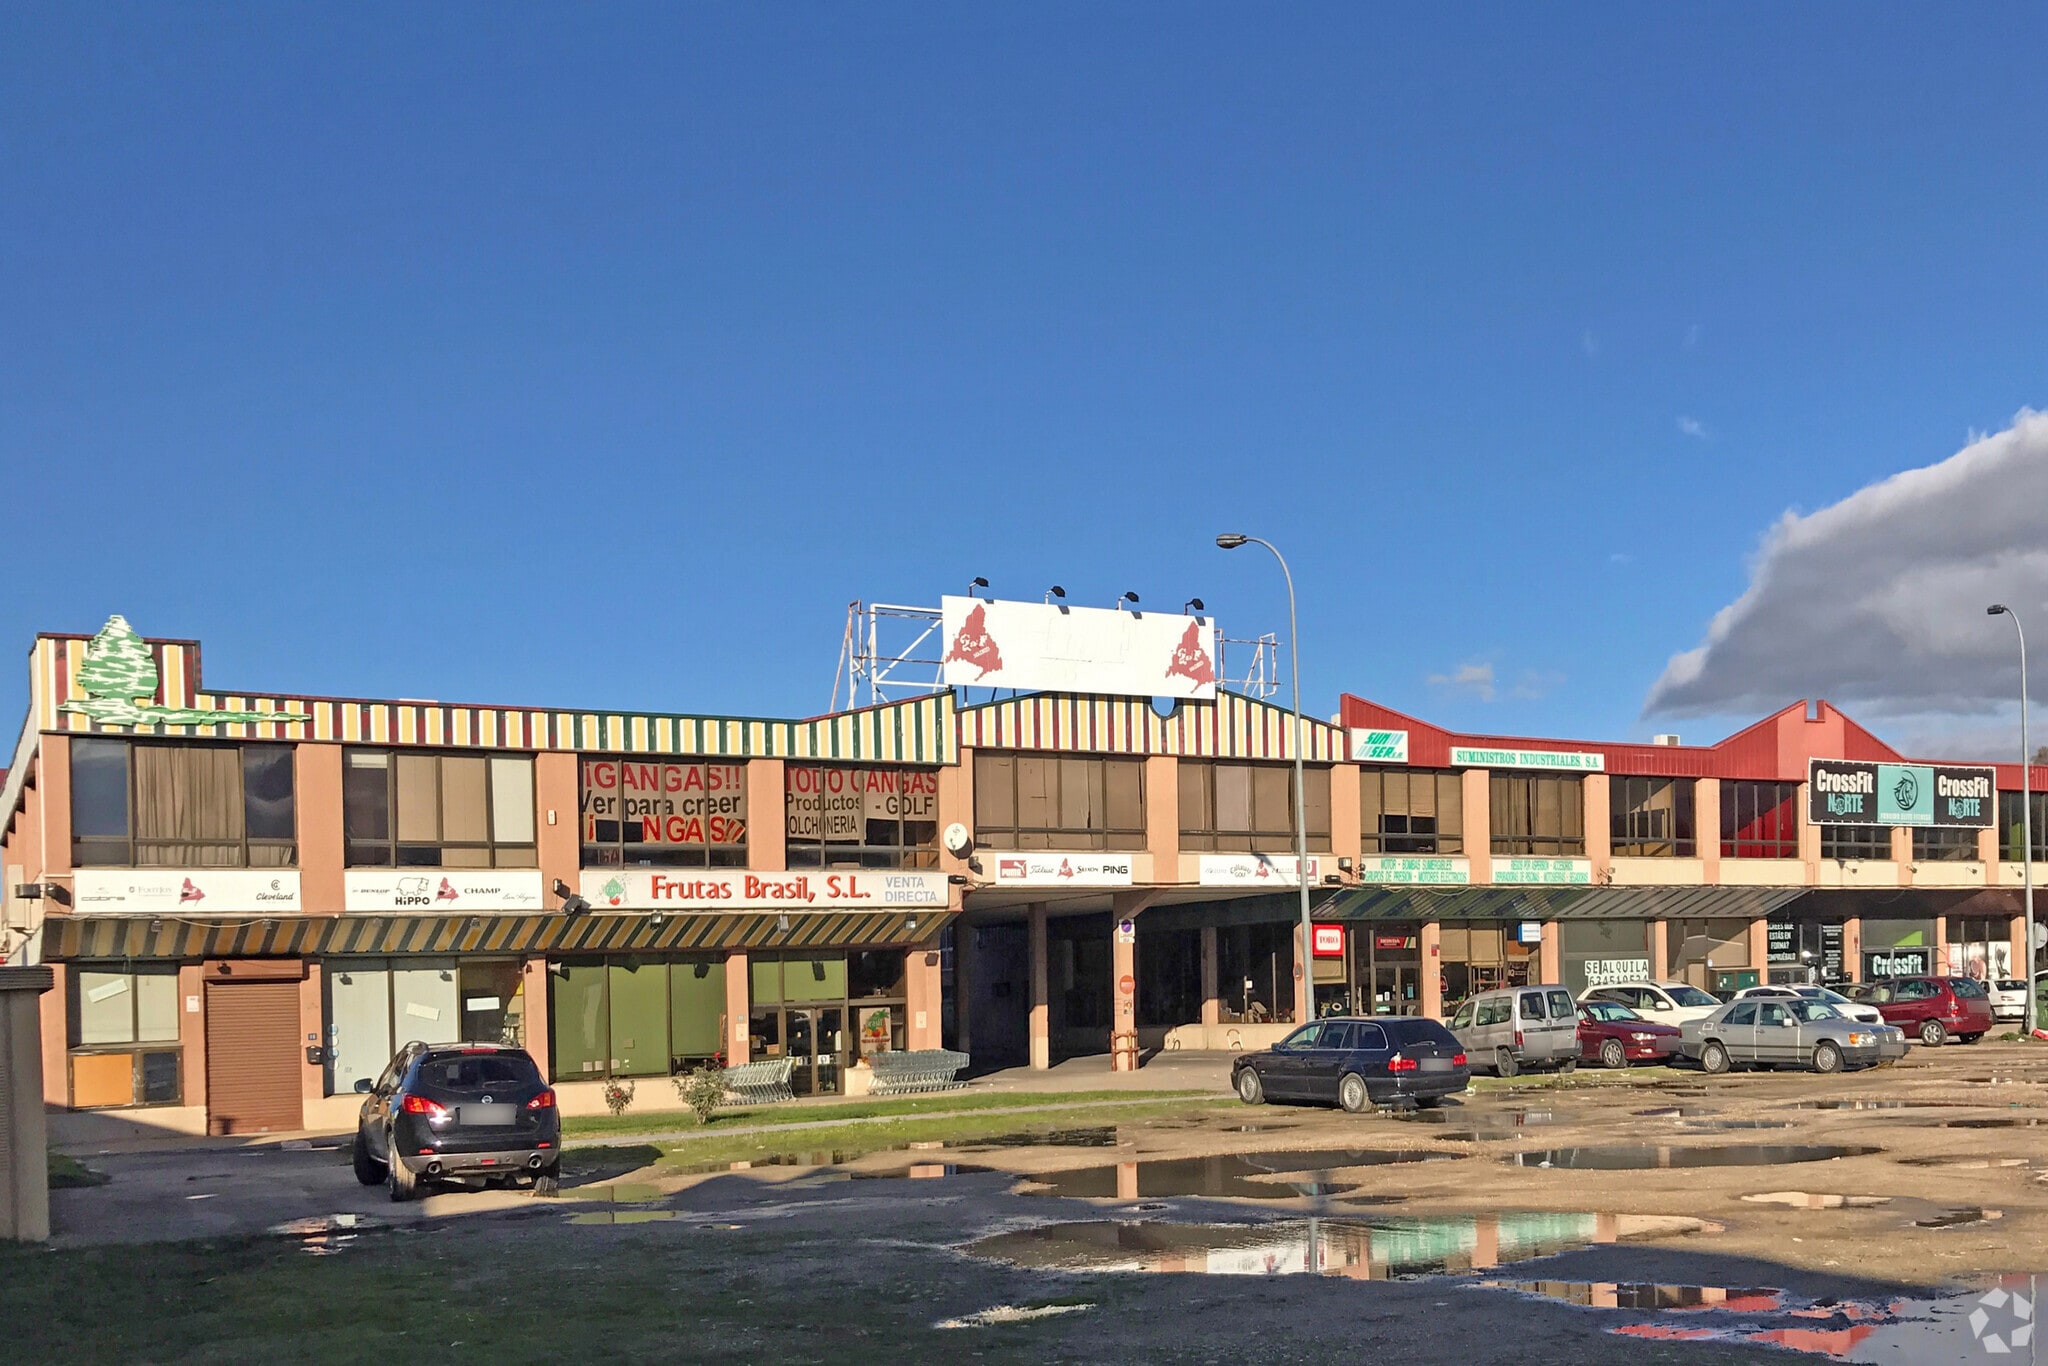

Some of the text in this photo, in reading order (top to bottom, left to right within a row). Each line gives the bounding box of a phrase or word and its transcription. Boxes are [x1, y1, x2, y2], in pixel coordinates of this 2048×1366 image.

[1364, 732, 1391, 745] SUM
[1369, 746, 1395, 758] SER
[1456, 750, 1516, 765] SUMINISTROS
[1519, 754, 1583, 768] INDUSTRIALES,
[584, 760, 741, 792] ¡GANGAS!!
[786, 767, 844, 793] TODO
[1816, 769, 1874, 794] CrossFit
[1938, 775, 1990, 799] CrossFit
[583, 790, 741, 821] Ver para creer
[787, 793, 860, 812] Productos
[886, 796, 934, 816] GOLF
[1827, 793, 1864, 816] NORTE
[1948, 797, 1981, 819] NORTE
[786, 815, 858, 835] OLCHONERIA
[1102, 865, 1129, 874] PING
[464, 887, 501, 895] CHAMP
[651, 875, 872, 903] Frutas Brasil, S.L.
[885, 876, 925, 889] VENTA
[255, 892, 295, 902] Cleveland
[395, 896, 431, 906] HiPPO
[885, 890, 937, 903] DIRECTA
[1586, 960, 1648, 974] SE ALQUILA
[1872, 953, 1923, 976] CrossFit
